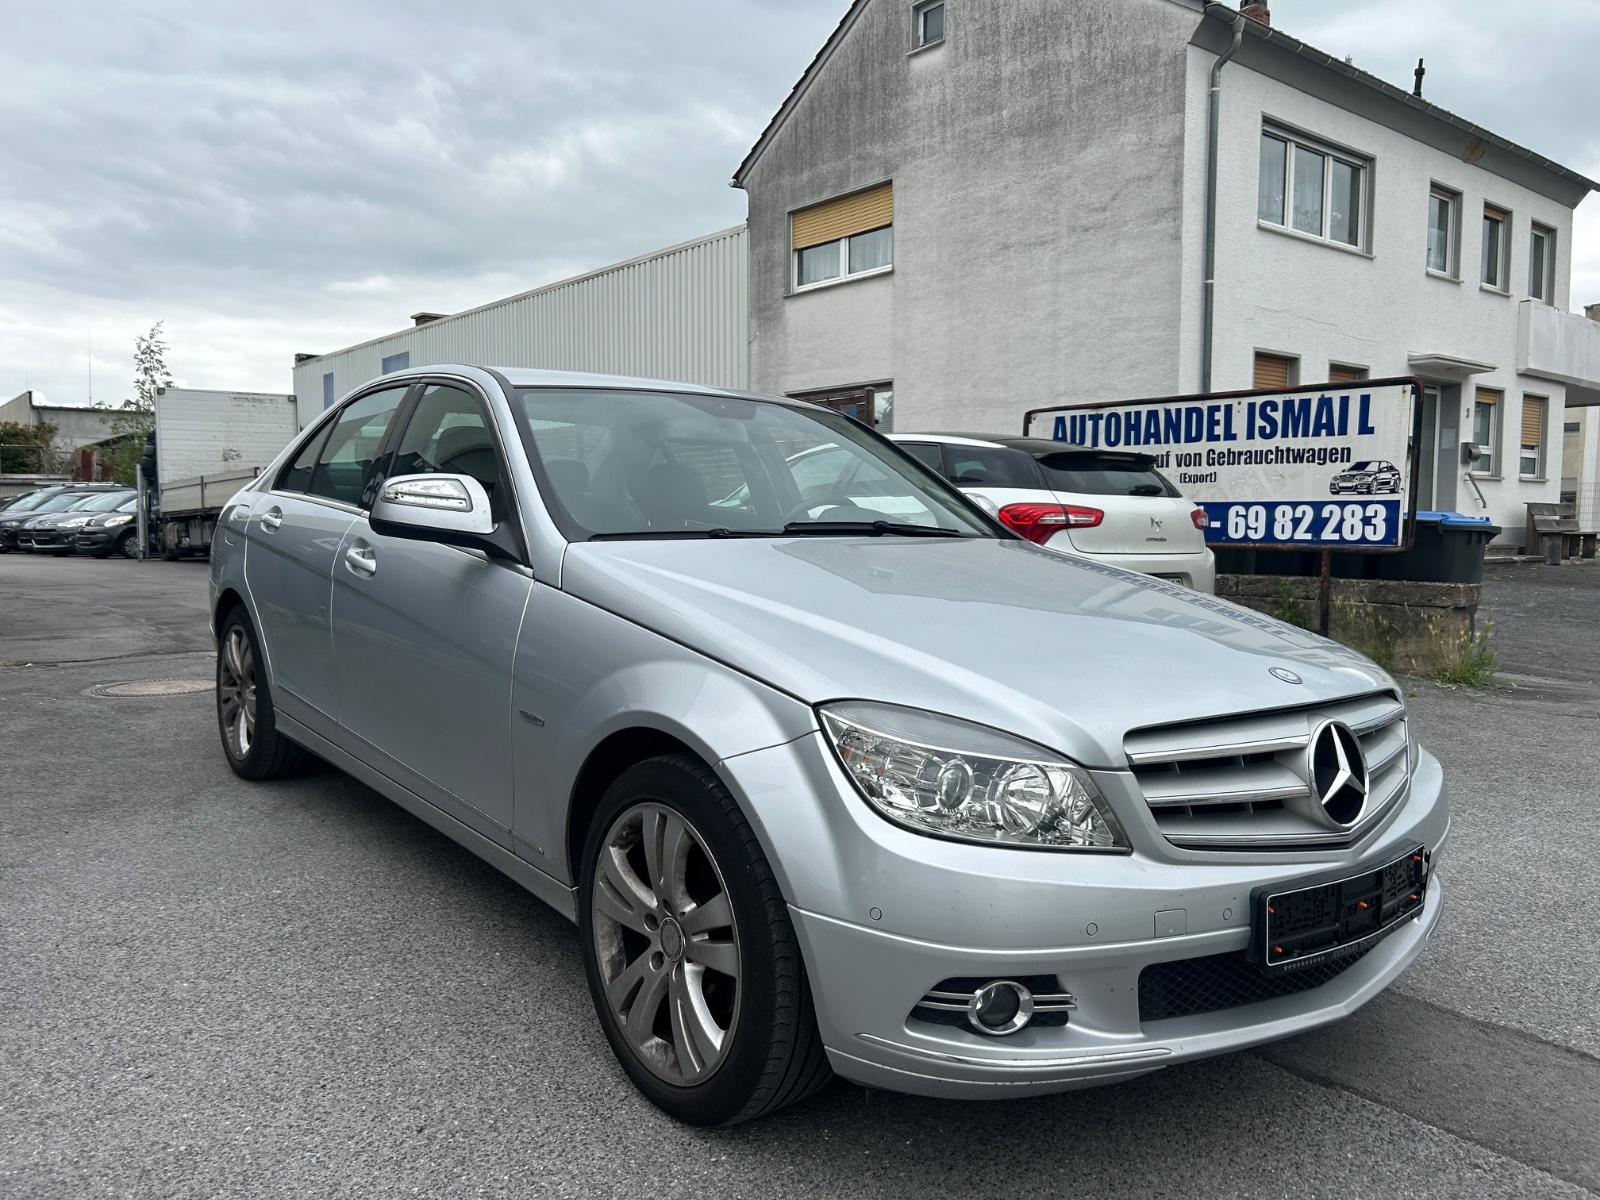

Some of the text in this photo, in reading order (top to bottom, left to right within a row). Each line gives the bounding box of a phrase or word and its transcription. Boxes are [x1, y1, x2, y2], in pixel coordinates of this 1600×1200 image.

[1052, 403, 1237, 448] AUTOHANDEL
[1175, 452, 1202, 467] von
[1206, 446, 1351, 467] Gebrauchtwagen
[1227, 505, 1267, 540] 69
[1273, 504, 1314, 540] 82
[1320, 504, 1387, 541] 283
